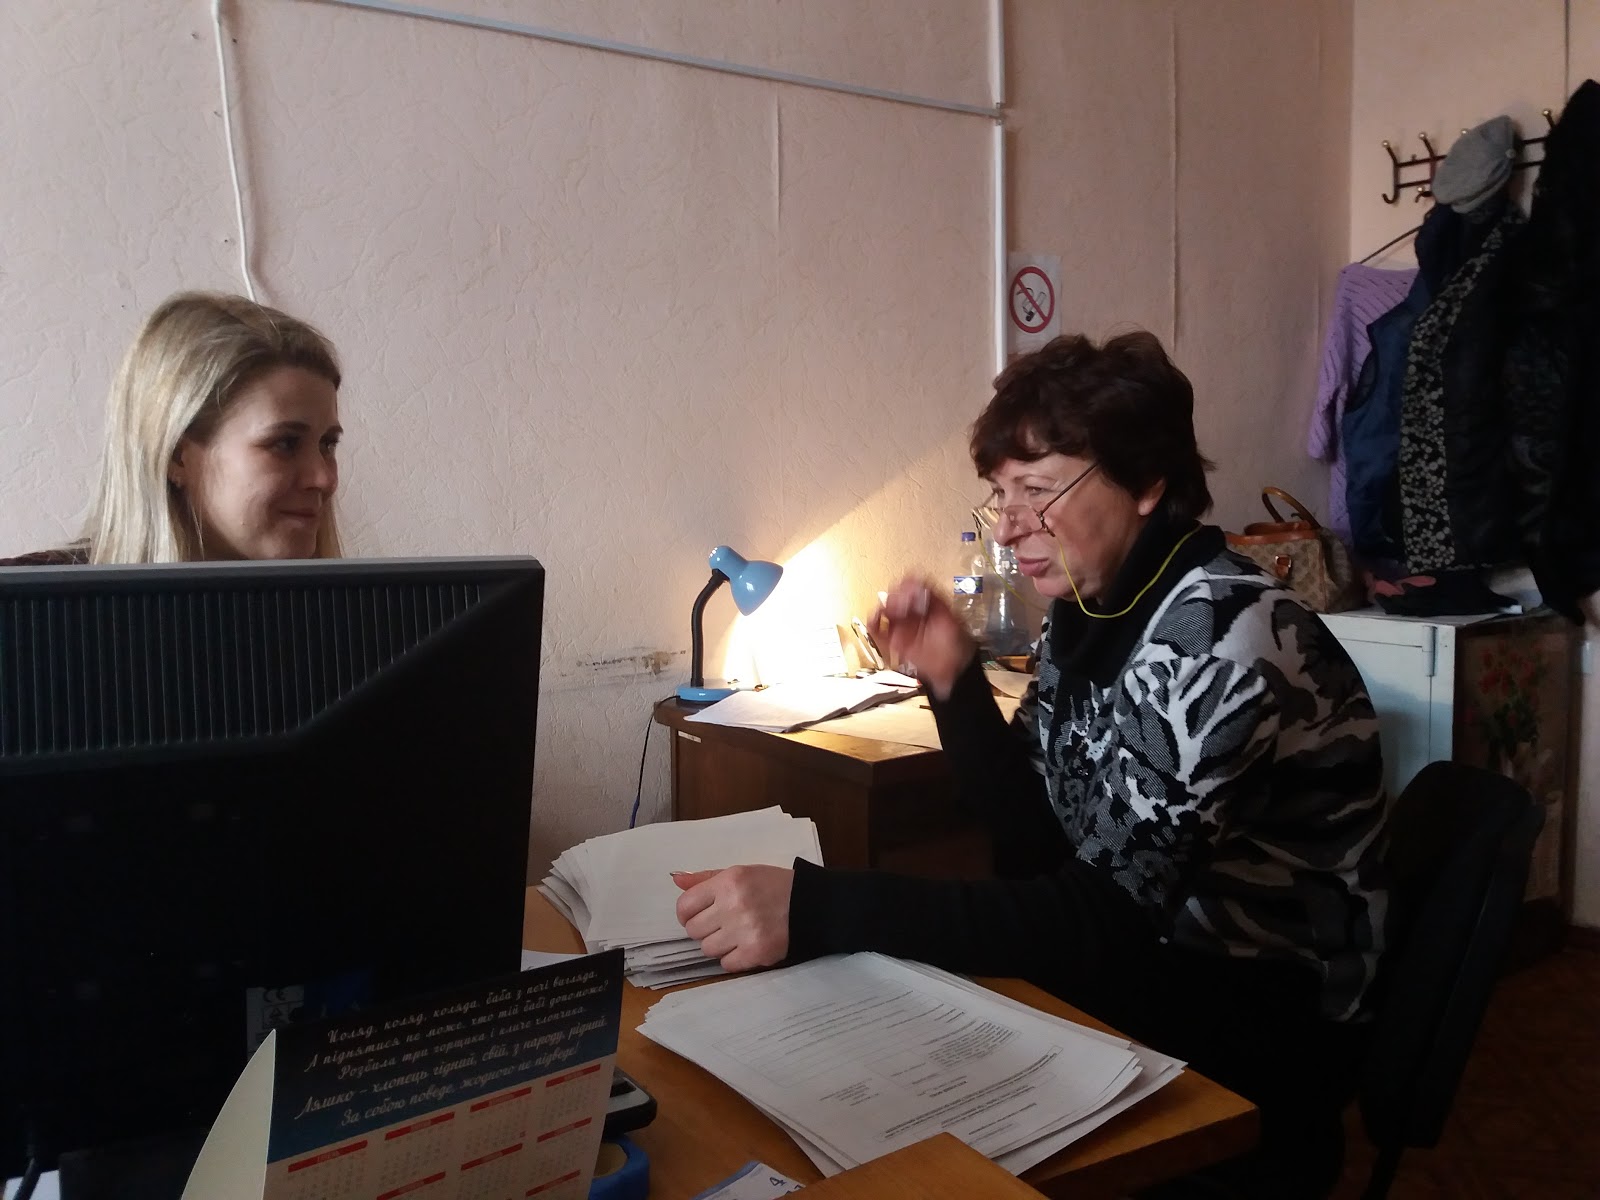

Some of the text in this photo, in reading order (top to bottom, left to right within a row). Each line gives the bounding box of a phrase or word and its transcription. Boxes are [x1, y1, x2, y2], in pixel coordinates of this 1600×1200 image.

[486, 989, 511, 1005] баба
[526, 980, 549, 995] печі
[323, 1037, 400, 1066] піднятися
[406, 1032, 421, 1043] не
[471, 1014, 494, 1026] хто
[549, 979, 609, 1009] допоможе?
[337, 1057, 397, 1080] Розбила
[401, 1048, 429, 1063] три
[498, 1020, 531, 1036] кличе
[294, 1089, 356, 1120] Ляшко
[372, 1070, 430, 1094] хлопець
[341, 1108, 361, 1126] За
[364, 1096, 406, 1119] собою
[459, 1065, 517, 1089] жодного
[518, 1060, 531, 1072] не
[769, 1177, 787, 1187] 4
